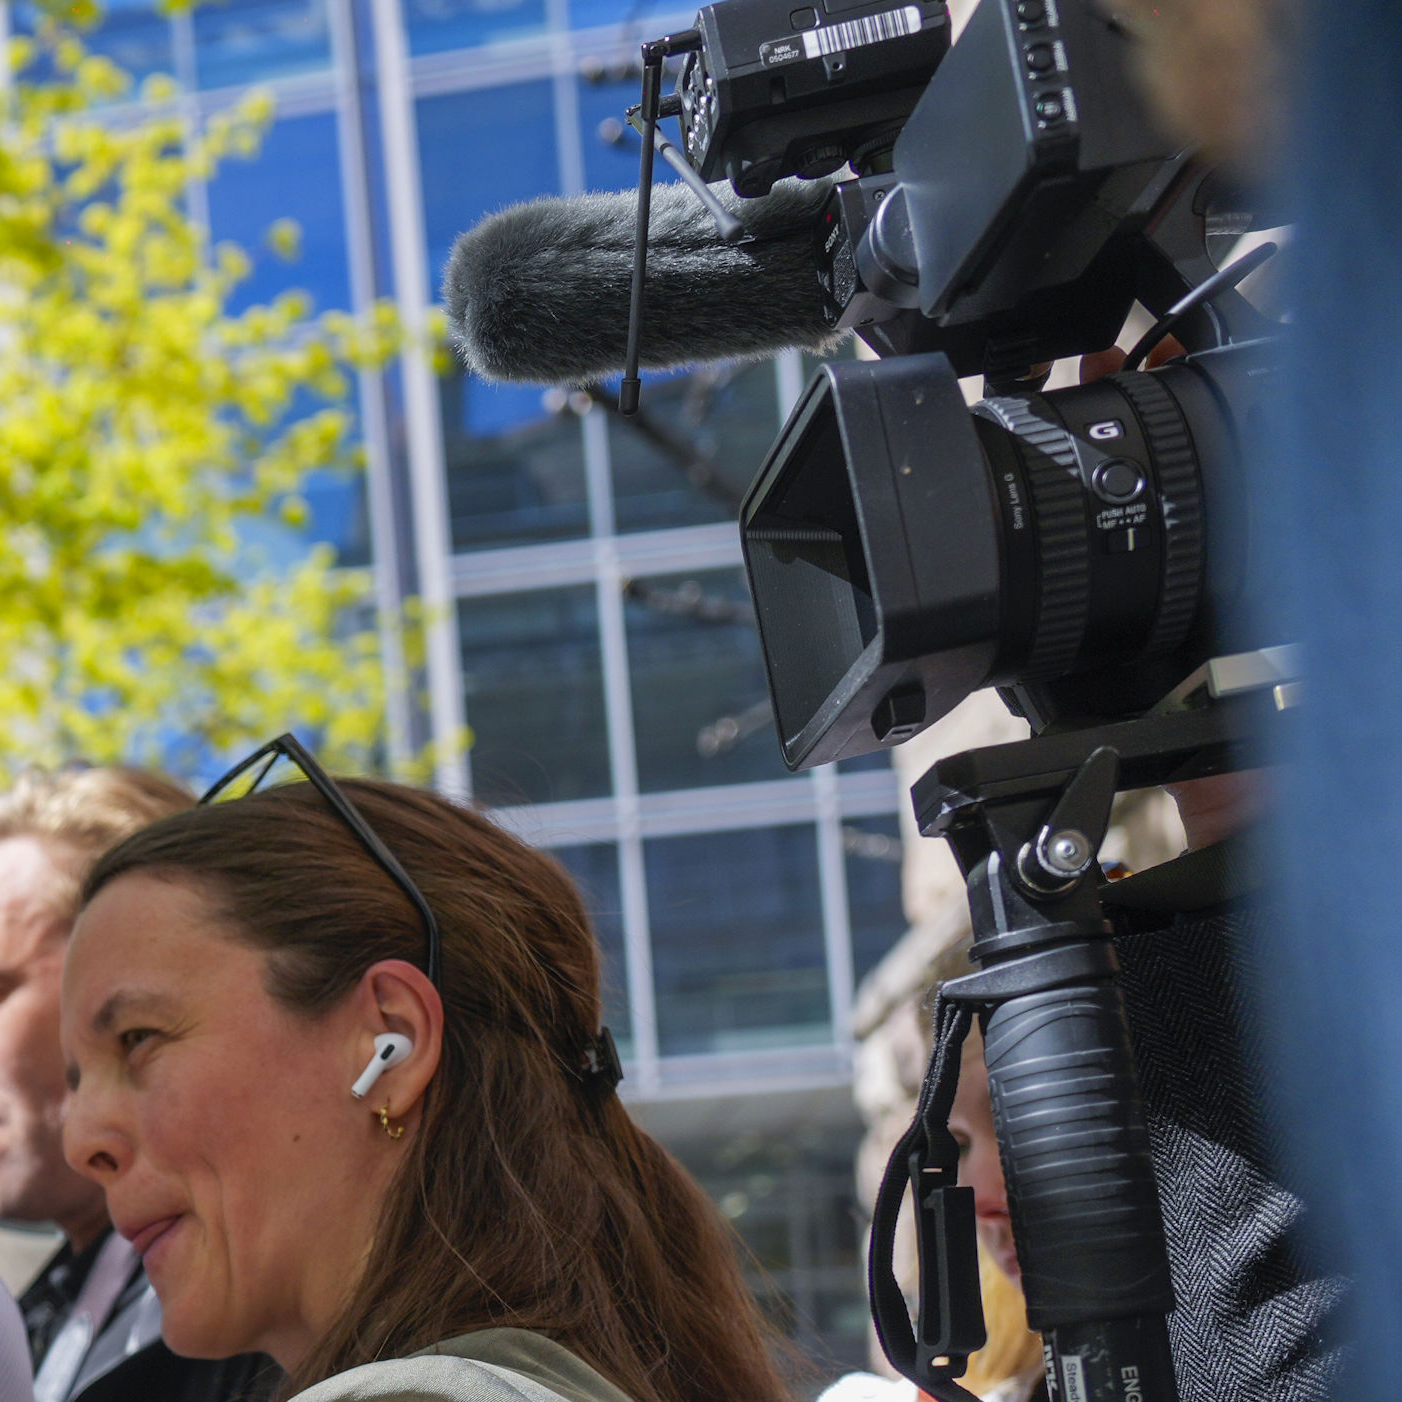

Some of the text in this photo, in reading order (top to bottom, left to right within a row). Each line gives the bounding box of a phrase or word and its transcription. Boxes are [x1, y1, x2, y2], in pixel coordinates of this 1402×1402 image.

[774, 44, 791, 54] NRK
[824, 223, 839, 253] SONY
[1089, 421, 1121, 440] G
[1003, 472, 1025, 530] Sony Lens G
[1101, 503, 1148, 520] PUSH AUTO
[1131, 514, 1147, 524] AF
